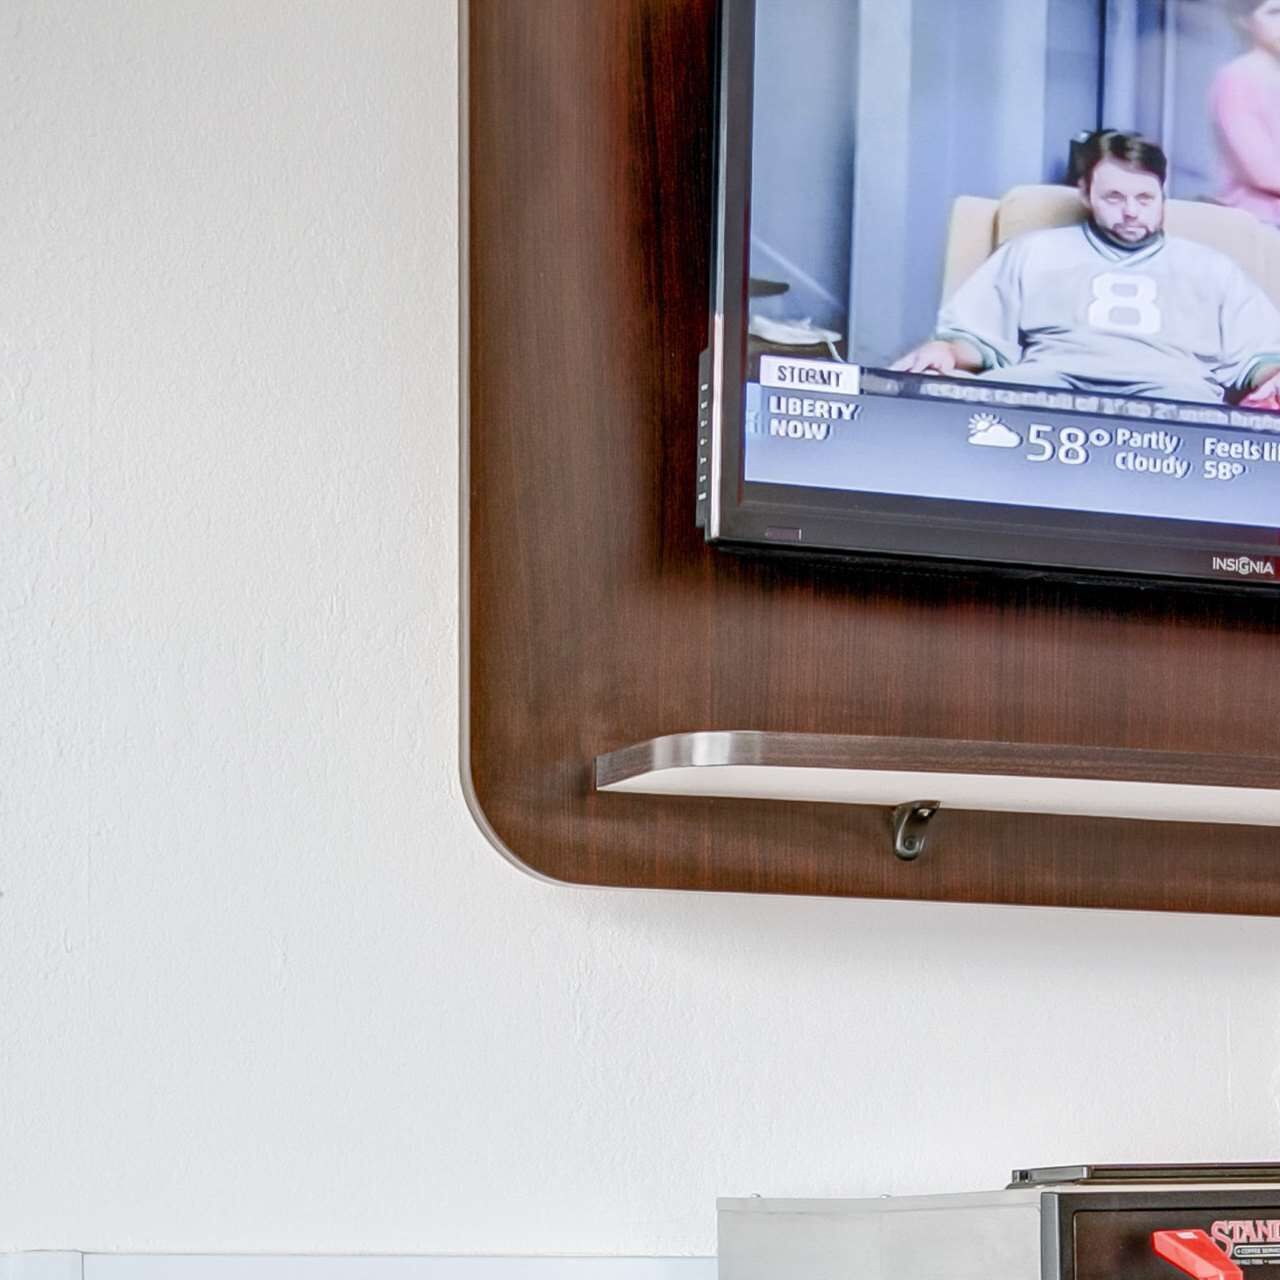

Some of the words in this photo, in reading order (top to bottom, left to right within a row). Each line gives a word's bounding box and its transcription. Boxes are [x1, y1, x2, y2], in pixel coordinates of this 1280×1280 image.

[1088, 272, 1162, 334] 8
[769, 396, 856, 420] LIBERTY
[770, 418, 827, 440] NOW
[1116, 428, 1179, 454] Partly
[1204, 437, 1262, 461] Feels
[1115, 452, 1188, 478] Cloudy
[1212, 555, 1274, 576] INSIGNIA
